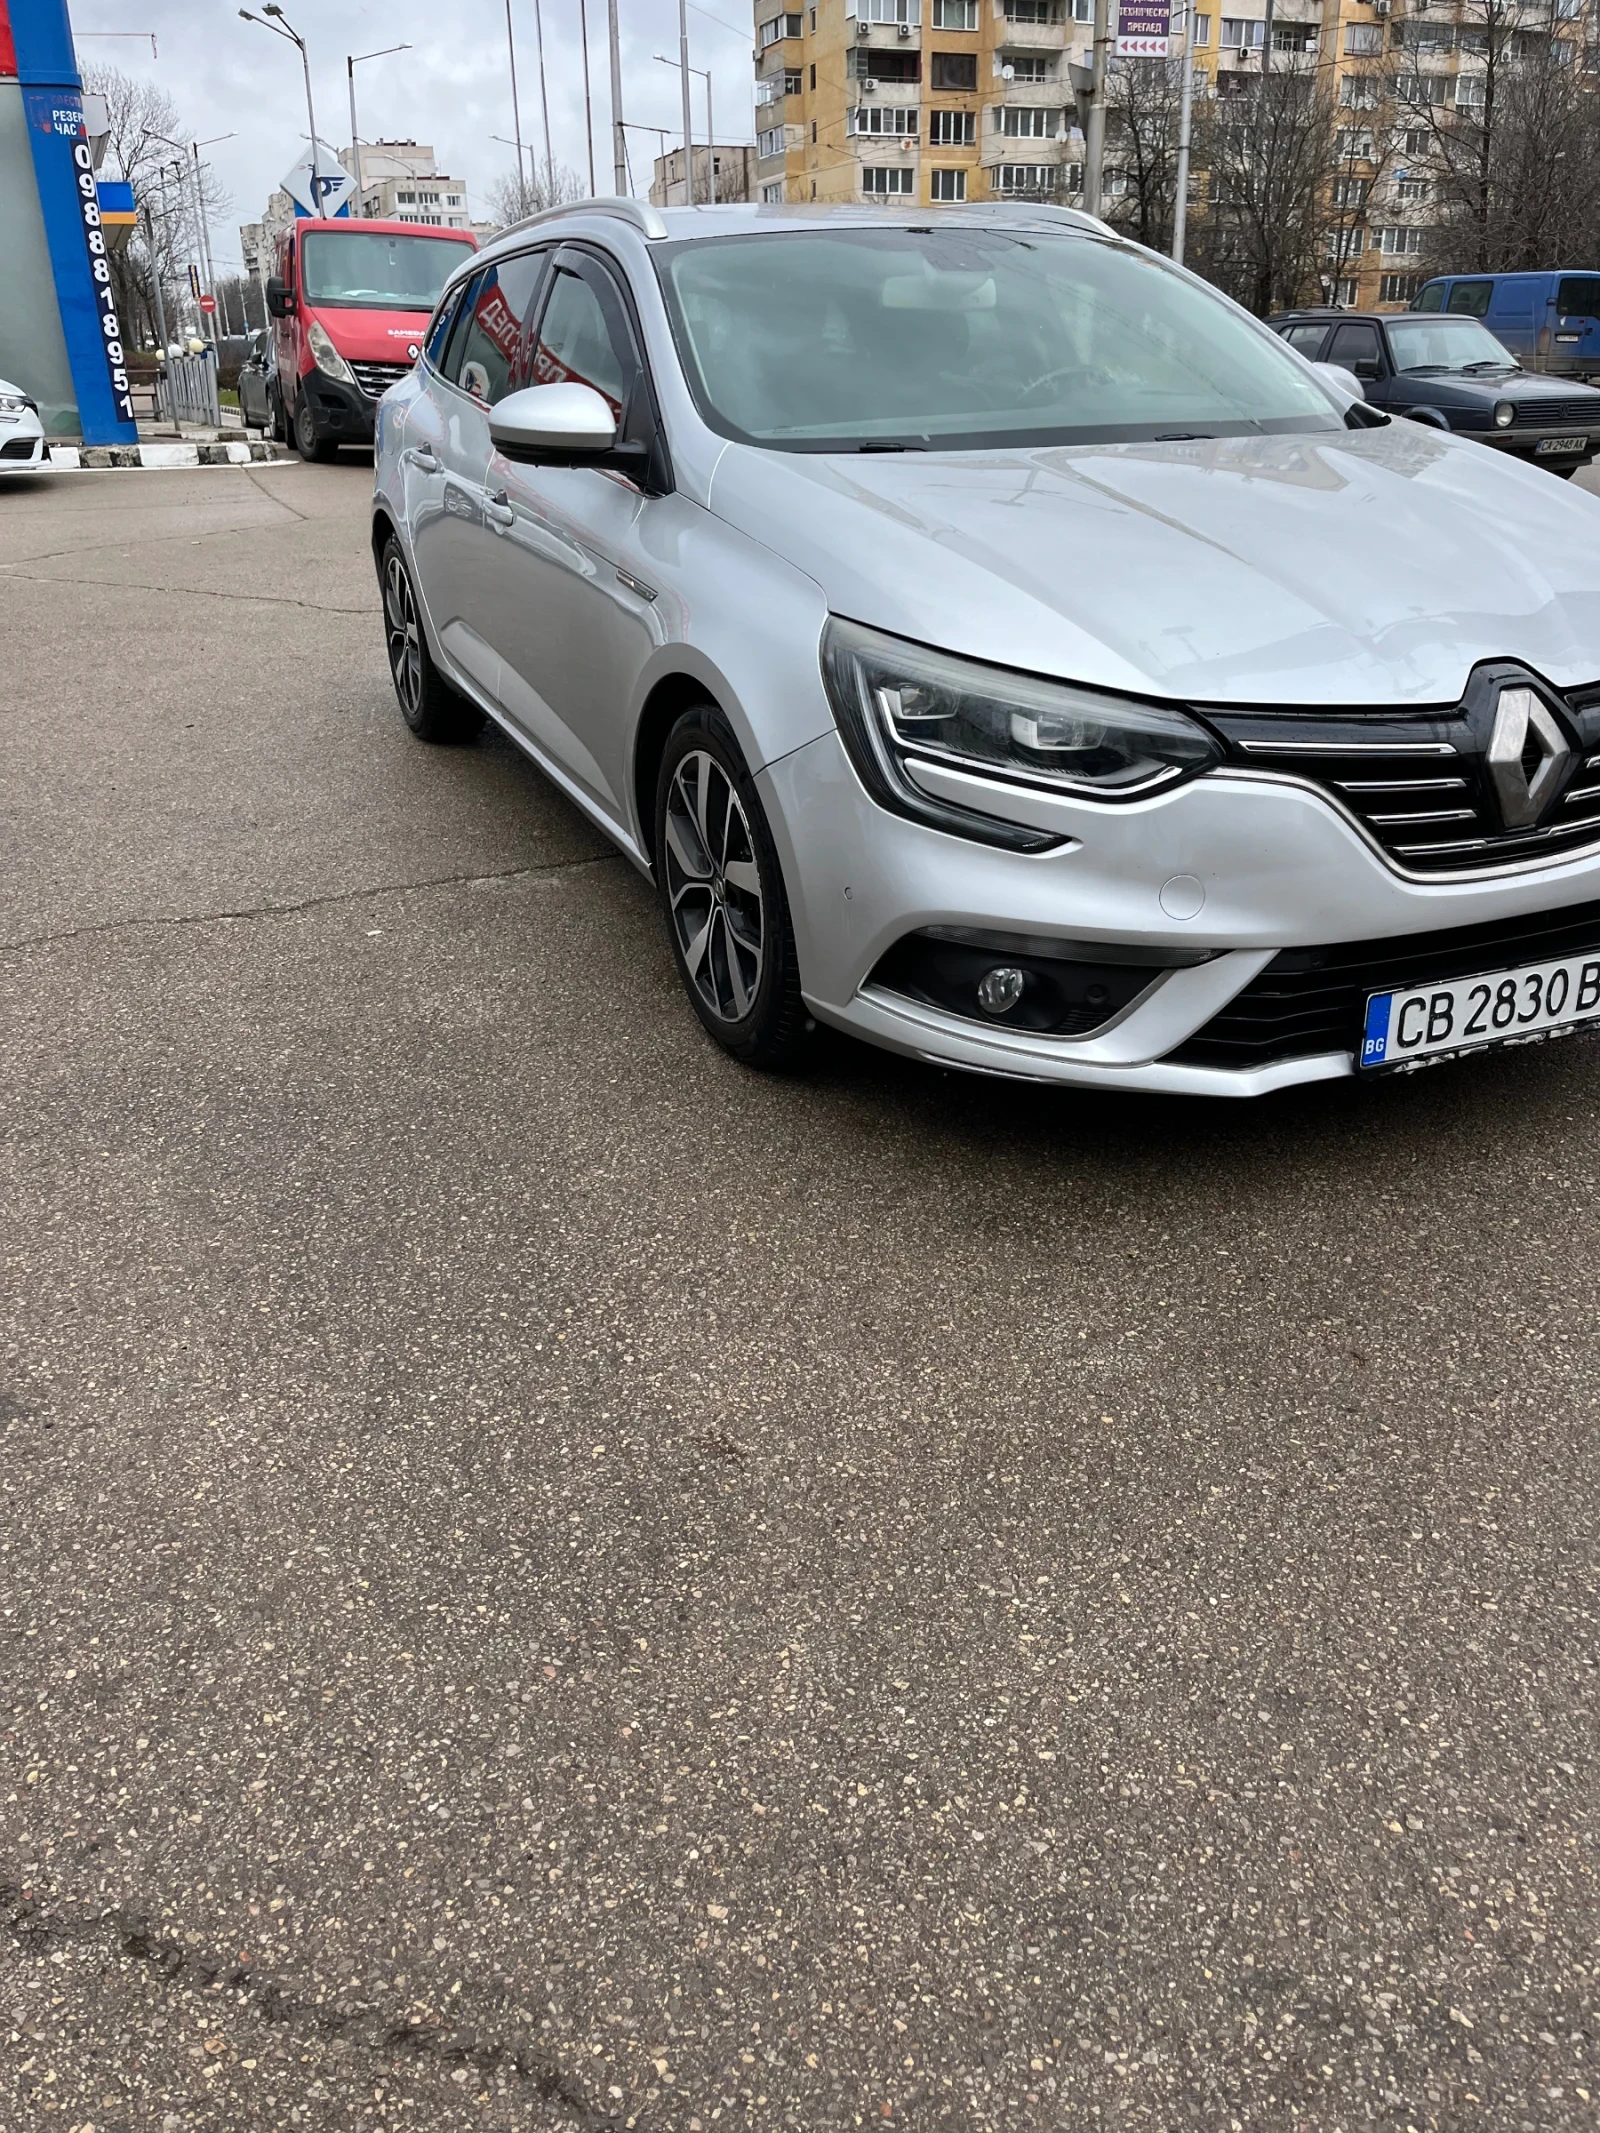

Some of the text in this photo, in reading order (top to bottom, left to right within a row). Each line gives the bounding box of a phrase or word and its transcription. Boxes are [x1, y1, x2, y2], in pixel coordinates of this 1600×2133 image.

[1119, 7, 1169, 17] ТЕХНИЧЕСКИ
[1127, 22, 1162, 33] ПРЕГЛЕД
[54, 123, 77, 136] ЧАС
[75, 144, 133, 418] 0988818951
[1397, 960, 1600, 1048] CB 2830 B
[1365, 1037, 1384, 1055] BG
